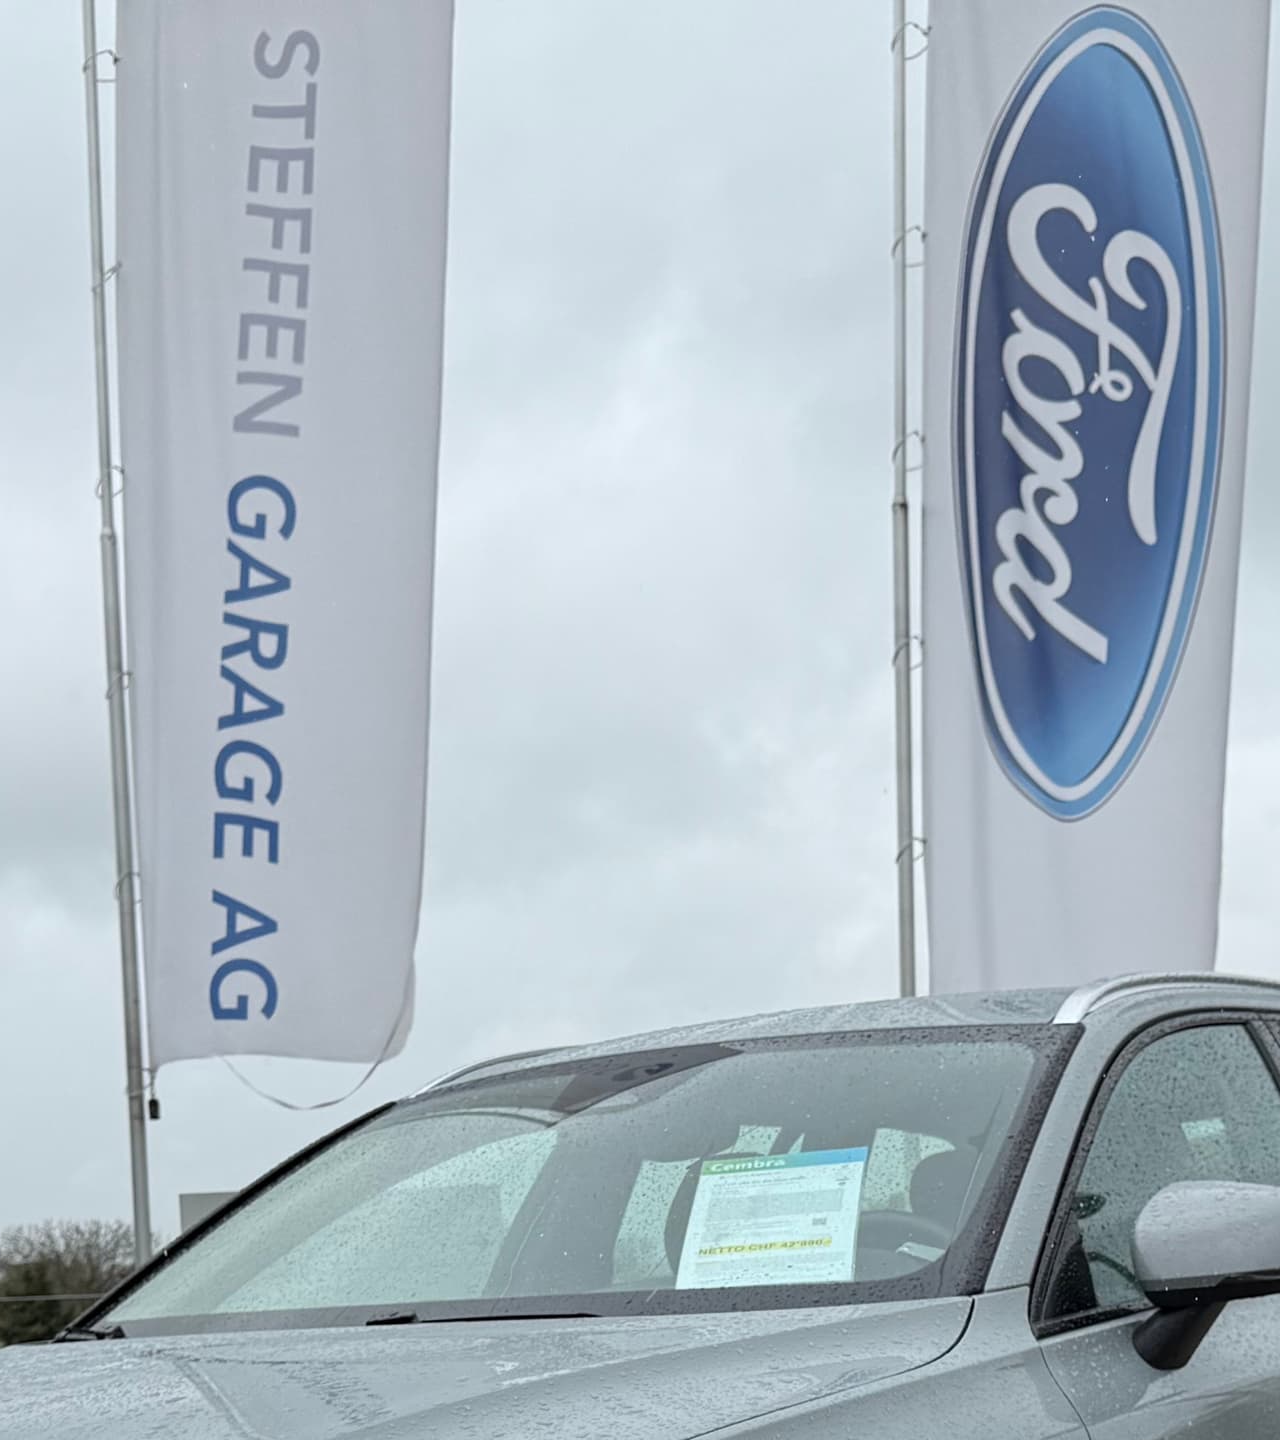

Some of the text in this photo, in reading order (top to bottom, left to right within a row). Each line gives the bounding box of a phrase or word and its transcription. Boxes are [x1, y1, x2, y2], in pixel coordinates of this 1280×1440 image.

[209, 29, 320, 1021] STEFFEN GARAGE AG
[992, 182, 1181, 664] Ford
[698, 1246, 744, 1256] NETTO
[710, 1158, 787, 1173] Cembra
